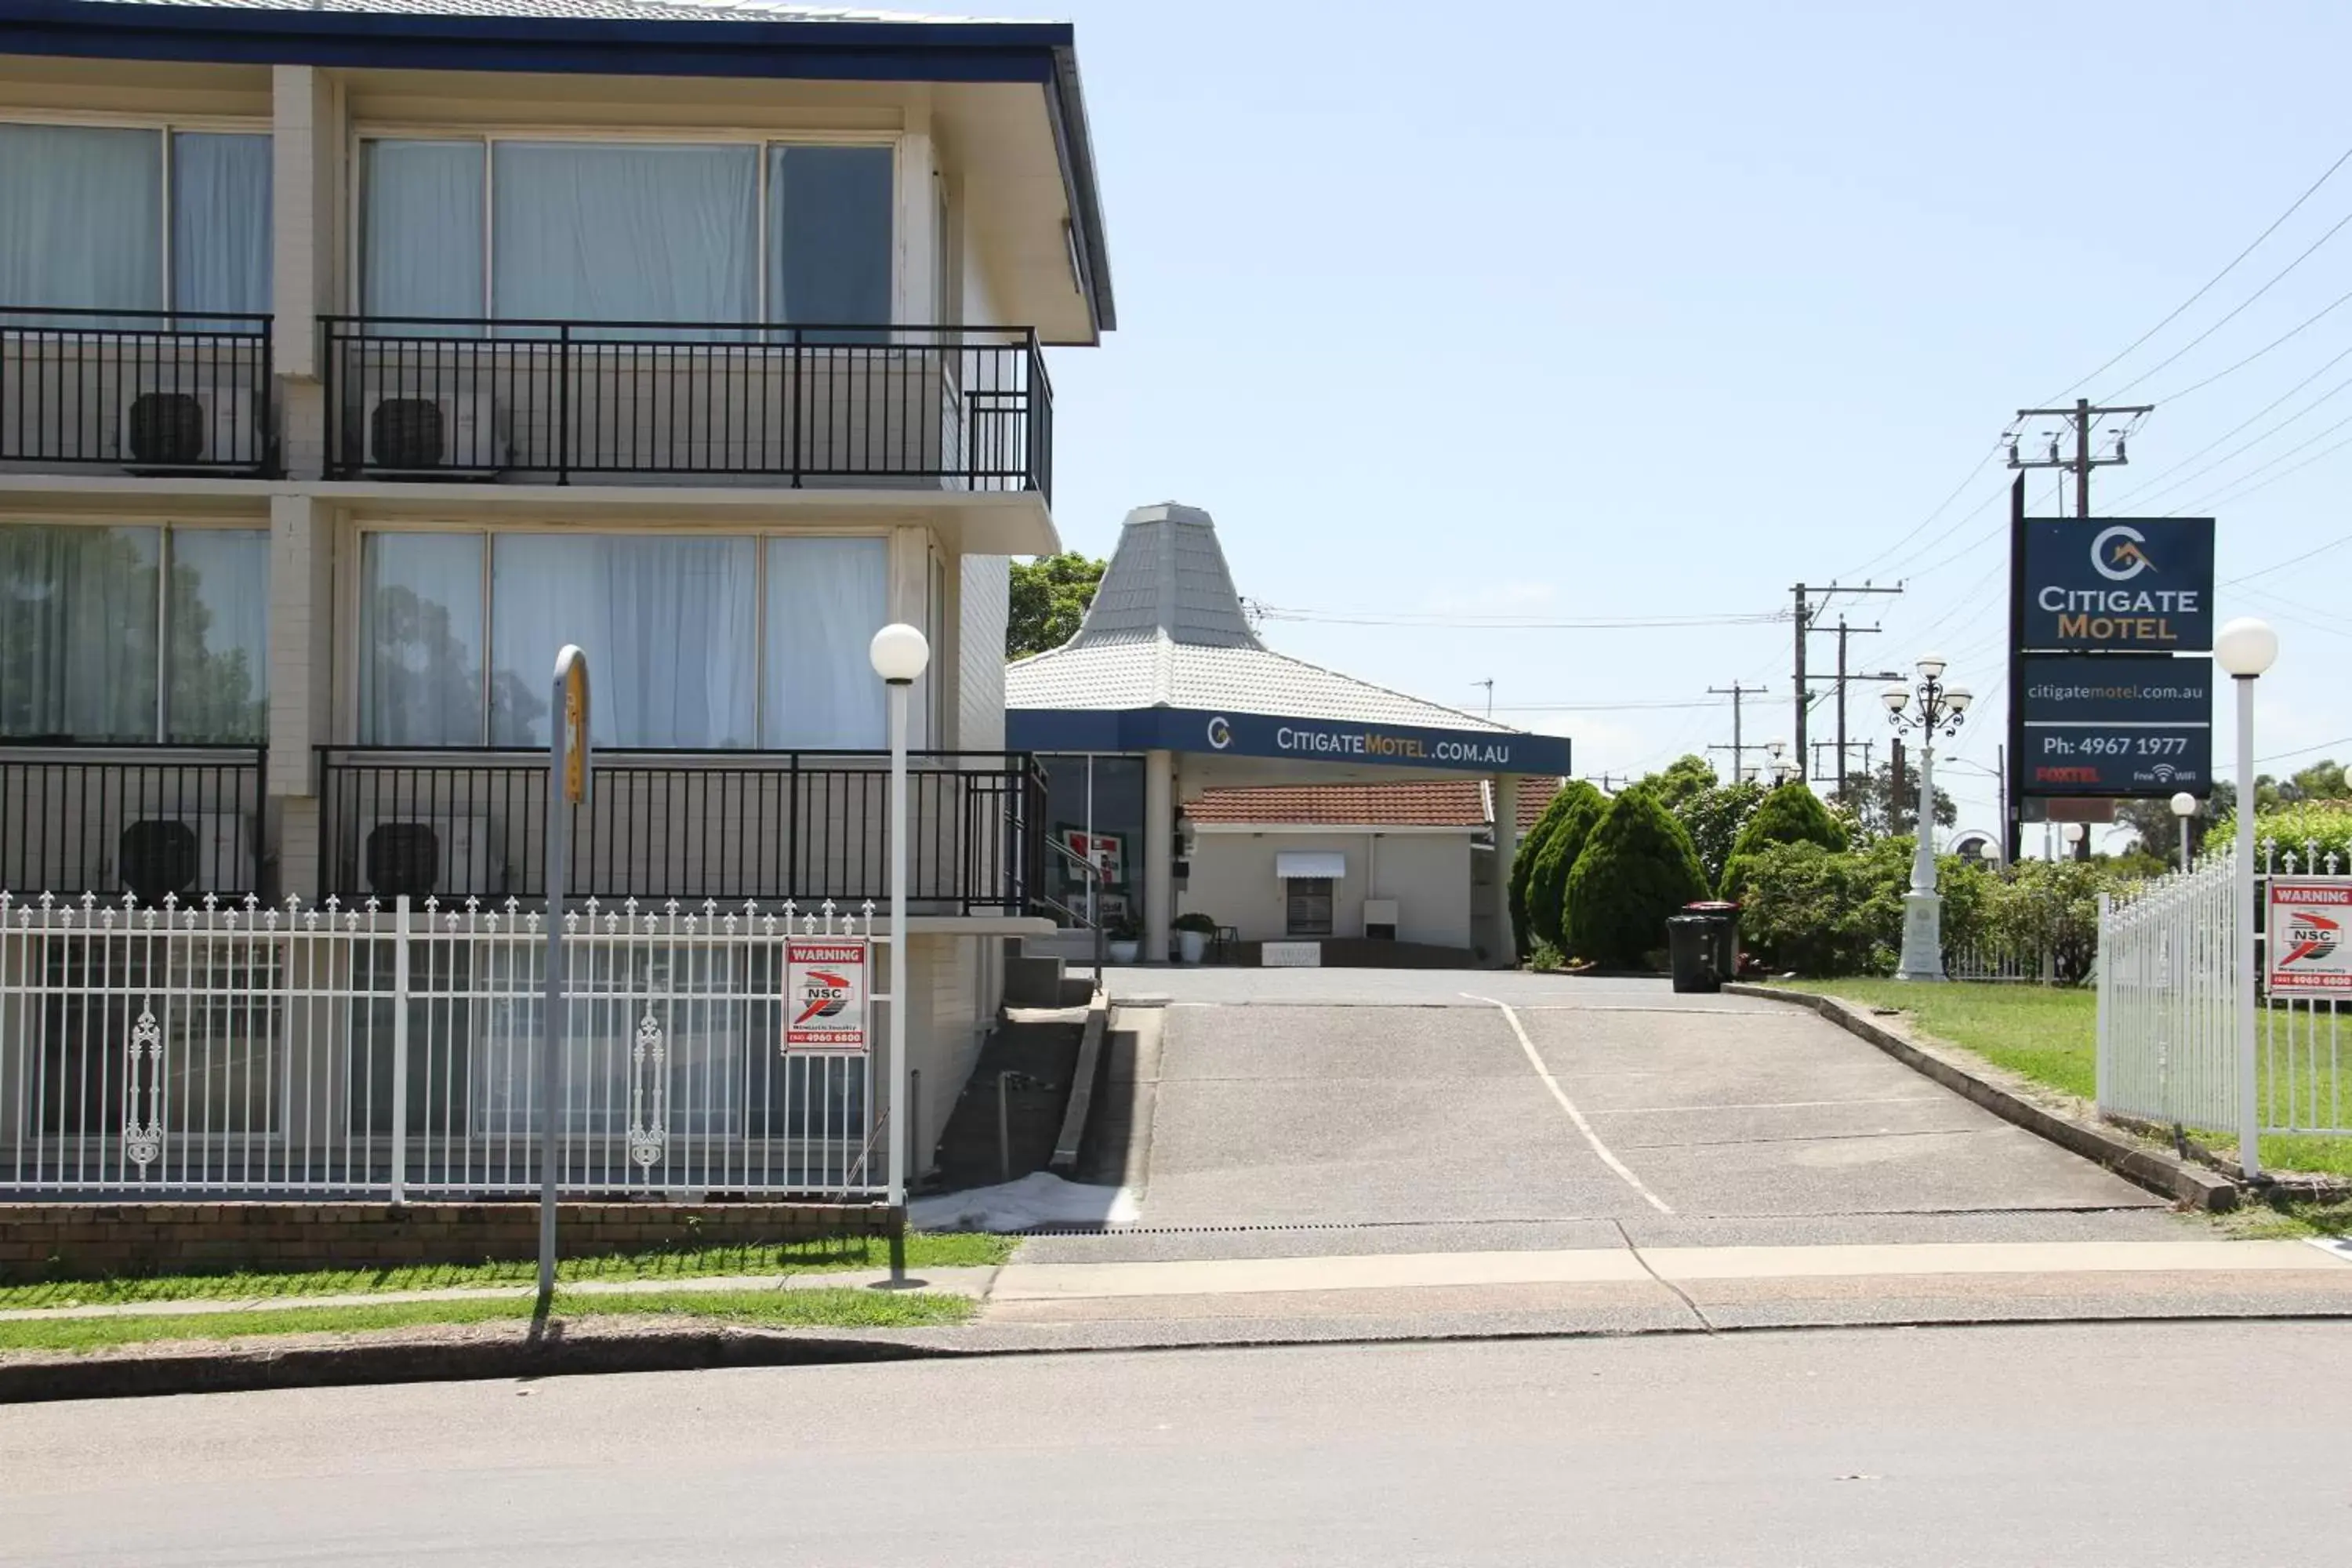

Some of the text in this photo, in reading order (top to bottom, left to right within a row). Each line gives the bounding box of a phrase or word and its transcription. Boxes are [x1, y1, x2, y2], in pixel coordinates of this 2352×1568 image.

[2038, 586, 2198, 613] CITIGATE
[2057, 614, 2177, 640] MOTEL
[2028, 684, 2203, 701] citigatemotel.com.au
[2043, 737, 2188, 755] Ph: 4967 1977
[2036, 767, 2100, 782] FOXTEL
[2133, 771, 2155, 781] Free
[2276, 890, 2349, 902] WARNING
[2294, 931, 2331, 941] NSC
[793, 949, 860, 961] WARNING
[808, 989, 842, 999] NSC
